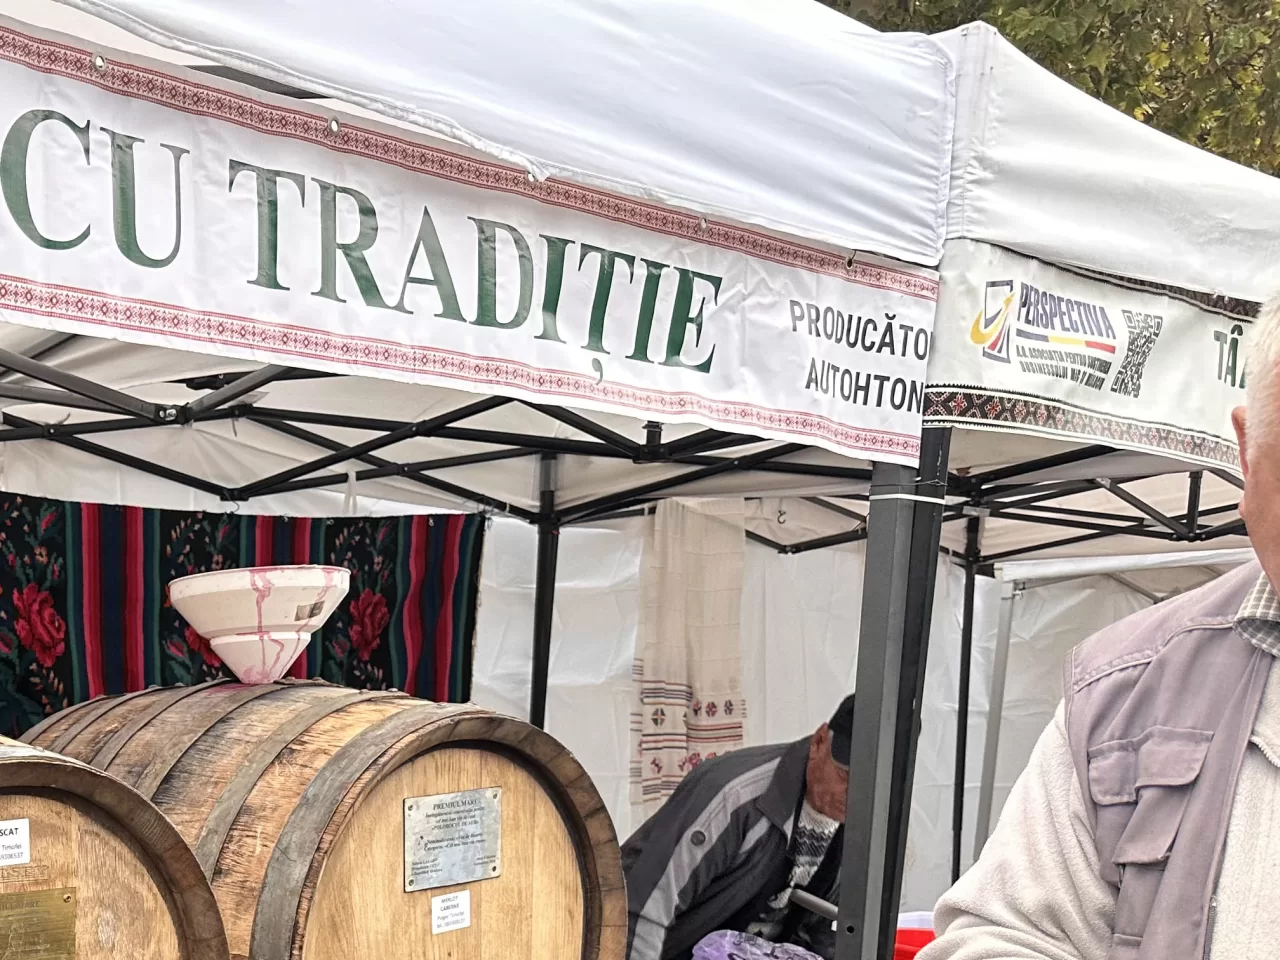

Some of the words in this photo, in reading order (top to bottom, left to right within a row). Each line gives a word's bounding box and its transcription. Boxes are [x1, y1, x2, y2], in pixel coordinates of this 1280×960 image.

[0, 108, 191, 268] CU
[228, 159, 724, 385] TRADIȚIE
[789, 299, 934, 361] PRODUCĂTO
[1017, 281, 1116, 340] PERSPECTIVA
[1213, 324, 1247, 389] TÂ
